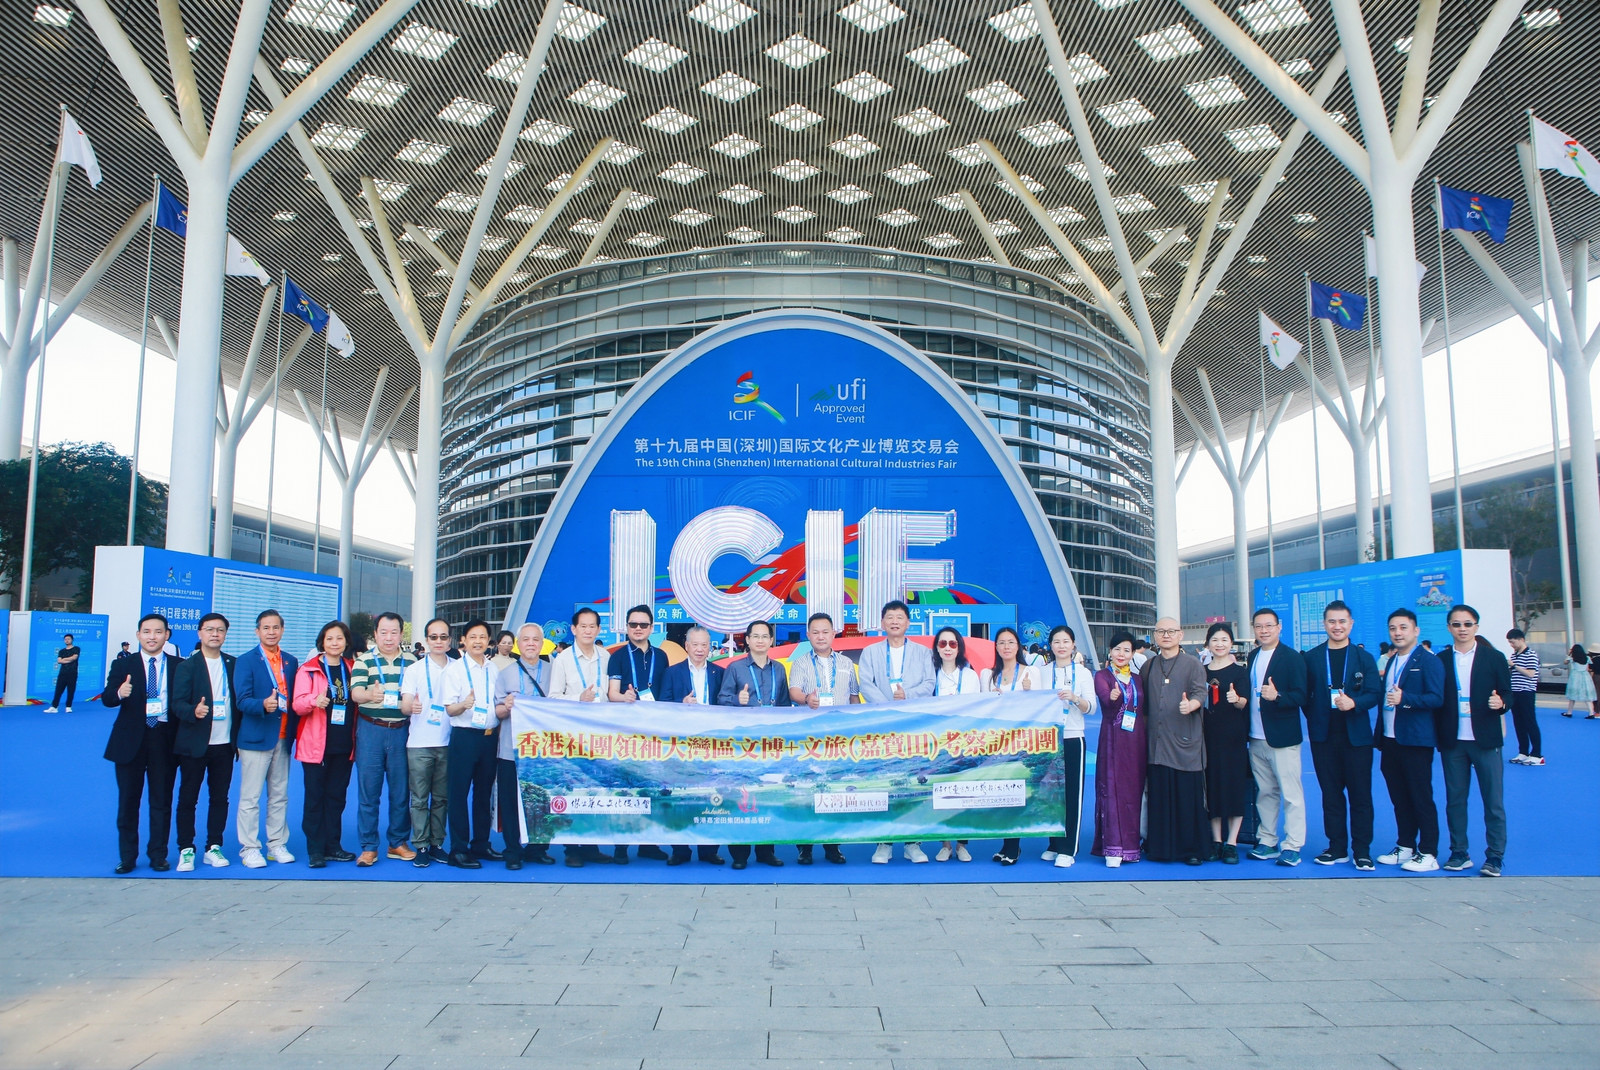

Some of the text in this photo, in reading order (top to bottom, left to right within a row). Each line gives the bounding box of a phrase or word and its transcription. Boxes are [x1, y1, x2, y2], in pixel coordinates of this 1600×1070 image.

[837, 377, 866, 401] ufi
[728, 409, 757, 421] ICIF
[813, 402, 866, 415] Approved
[836, 413, 866, 424] Event
[633, 437, 960, 455] 第十九届中国(深圳)国际文化产业博览交易会
[635, 457, 957, 469] The 19th China (Shenzhen) International Cultural Industries Fair
[609, 505, 957, 633] ICIF
